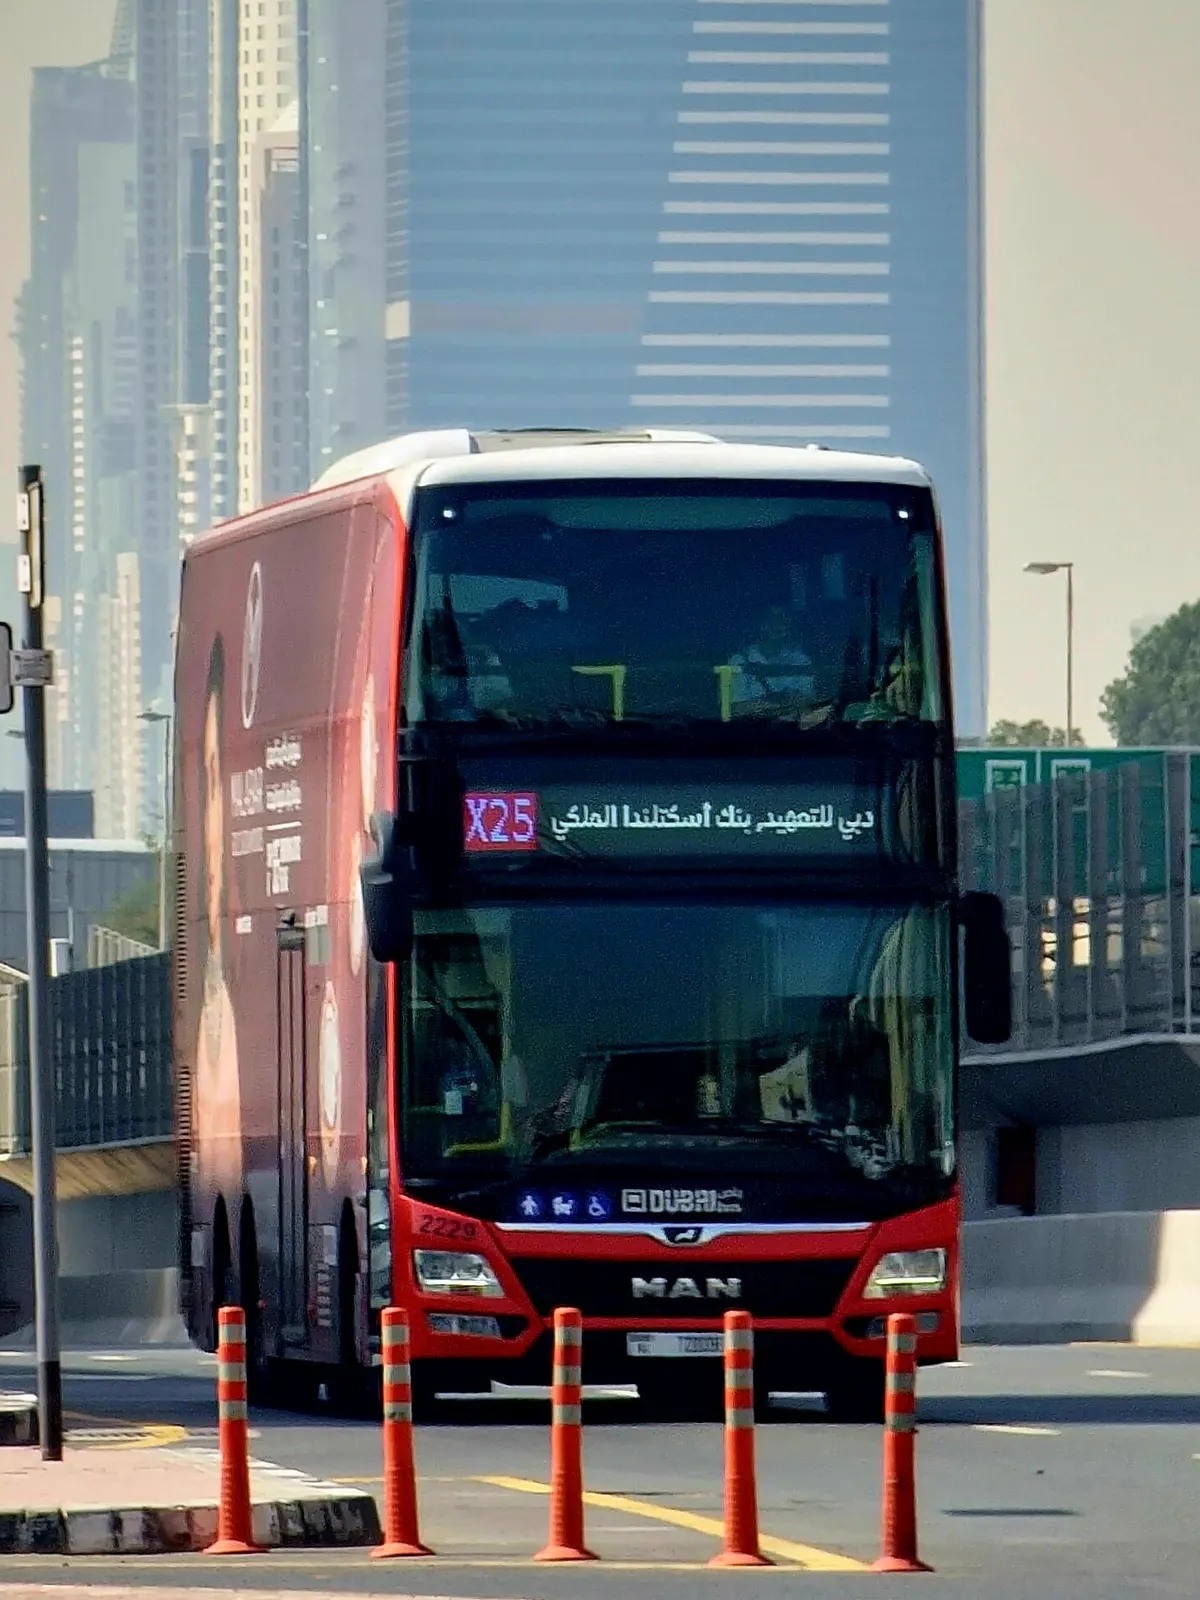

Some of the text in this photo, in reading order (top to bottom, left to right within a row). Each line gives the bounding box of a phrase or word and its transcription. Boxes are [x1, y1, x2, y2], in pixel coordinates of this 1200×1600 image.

[466, 799, 535, 842] X25
[551, 804, 618, 840] الملكي
[716, 804, 751, 834] بنك
[838, 811, 874, 840] دبي
[631, 1277, 742, 1298] MAN
